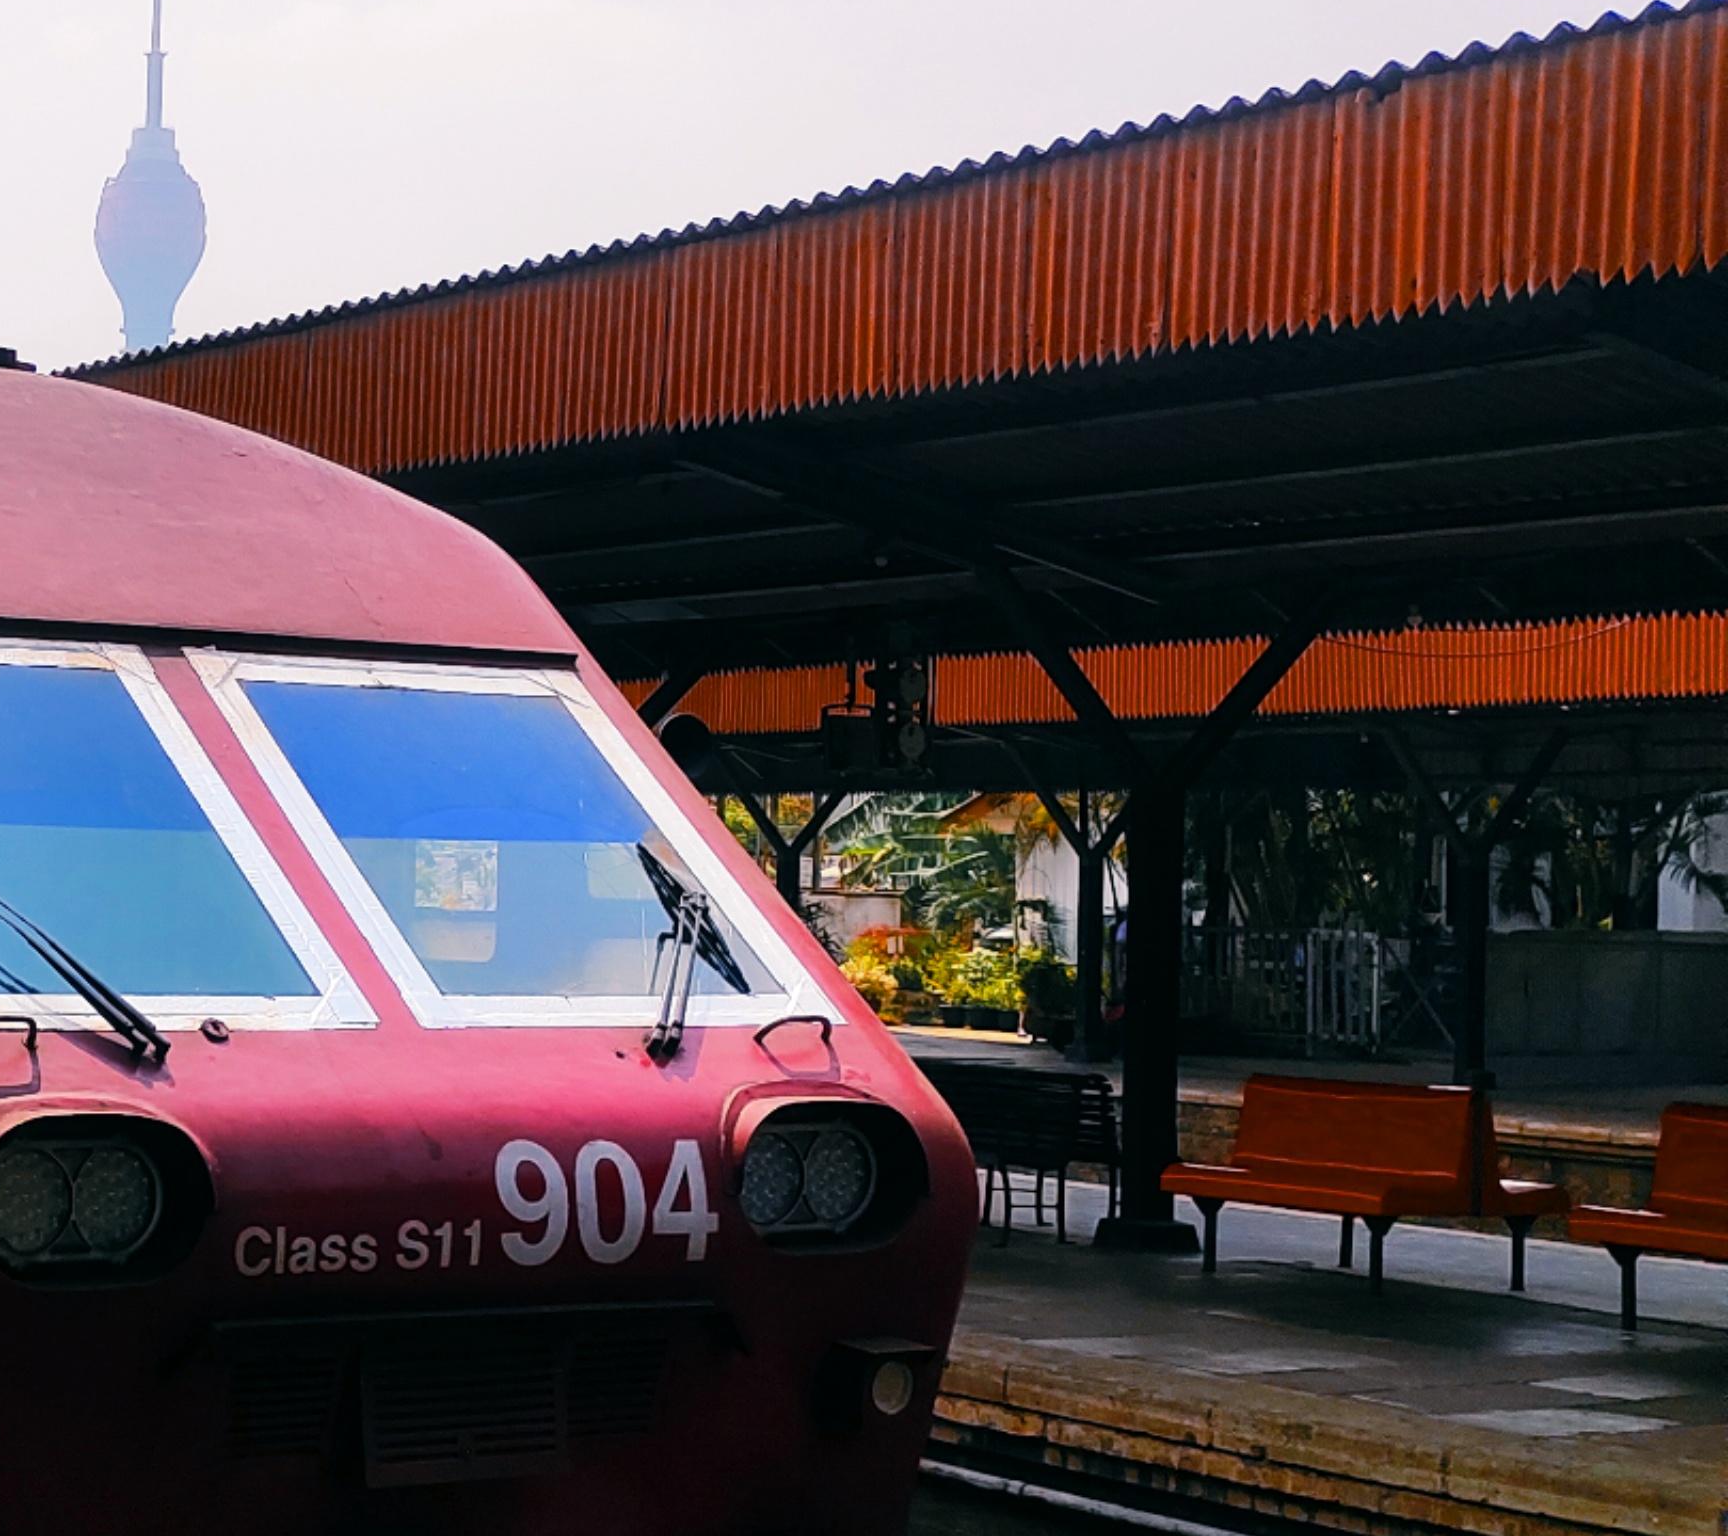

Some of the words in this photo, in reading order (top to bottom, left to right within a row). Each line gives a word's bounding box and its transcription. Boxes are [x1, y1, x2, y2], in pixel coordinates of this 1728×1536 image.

[234, 1226, 378, 1277] Class
[395, 1219, 482, 1270] S11
[494, 1138, 719, 1265] 904
